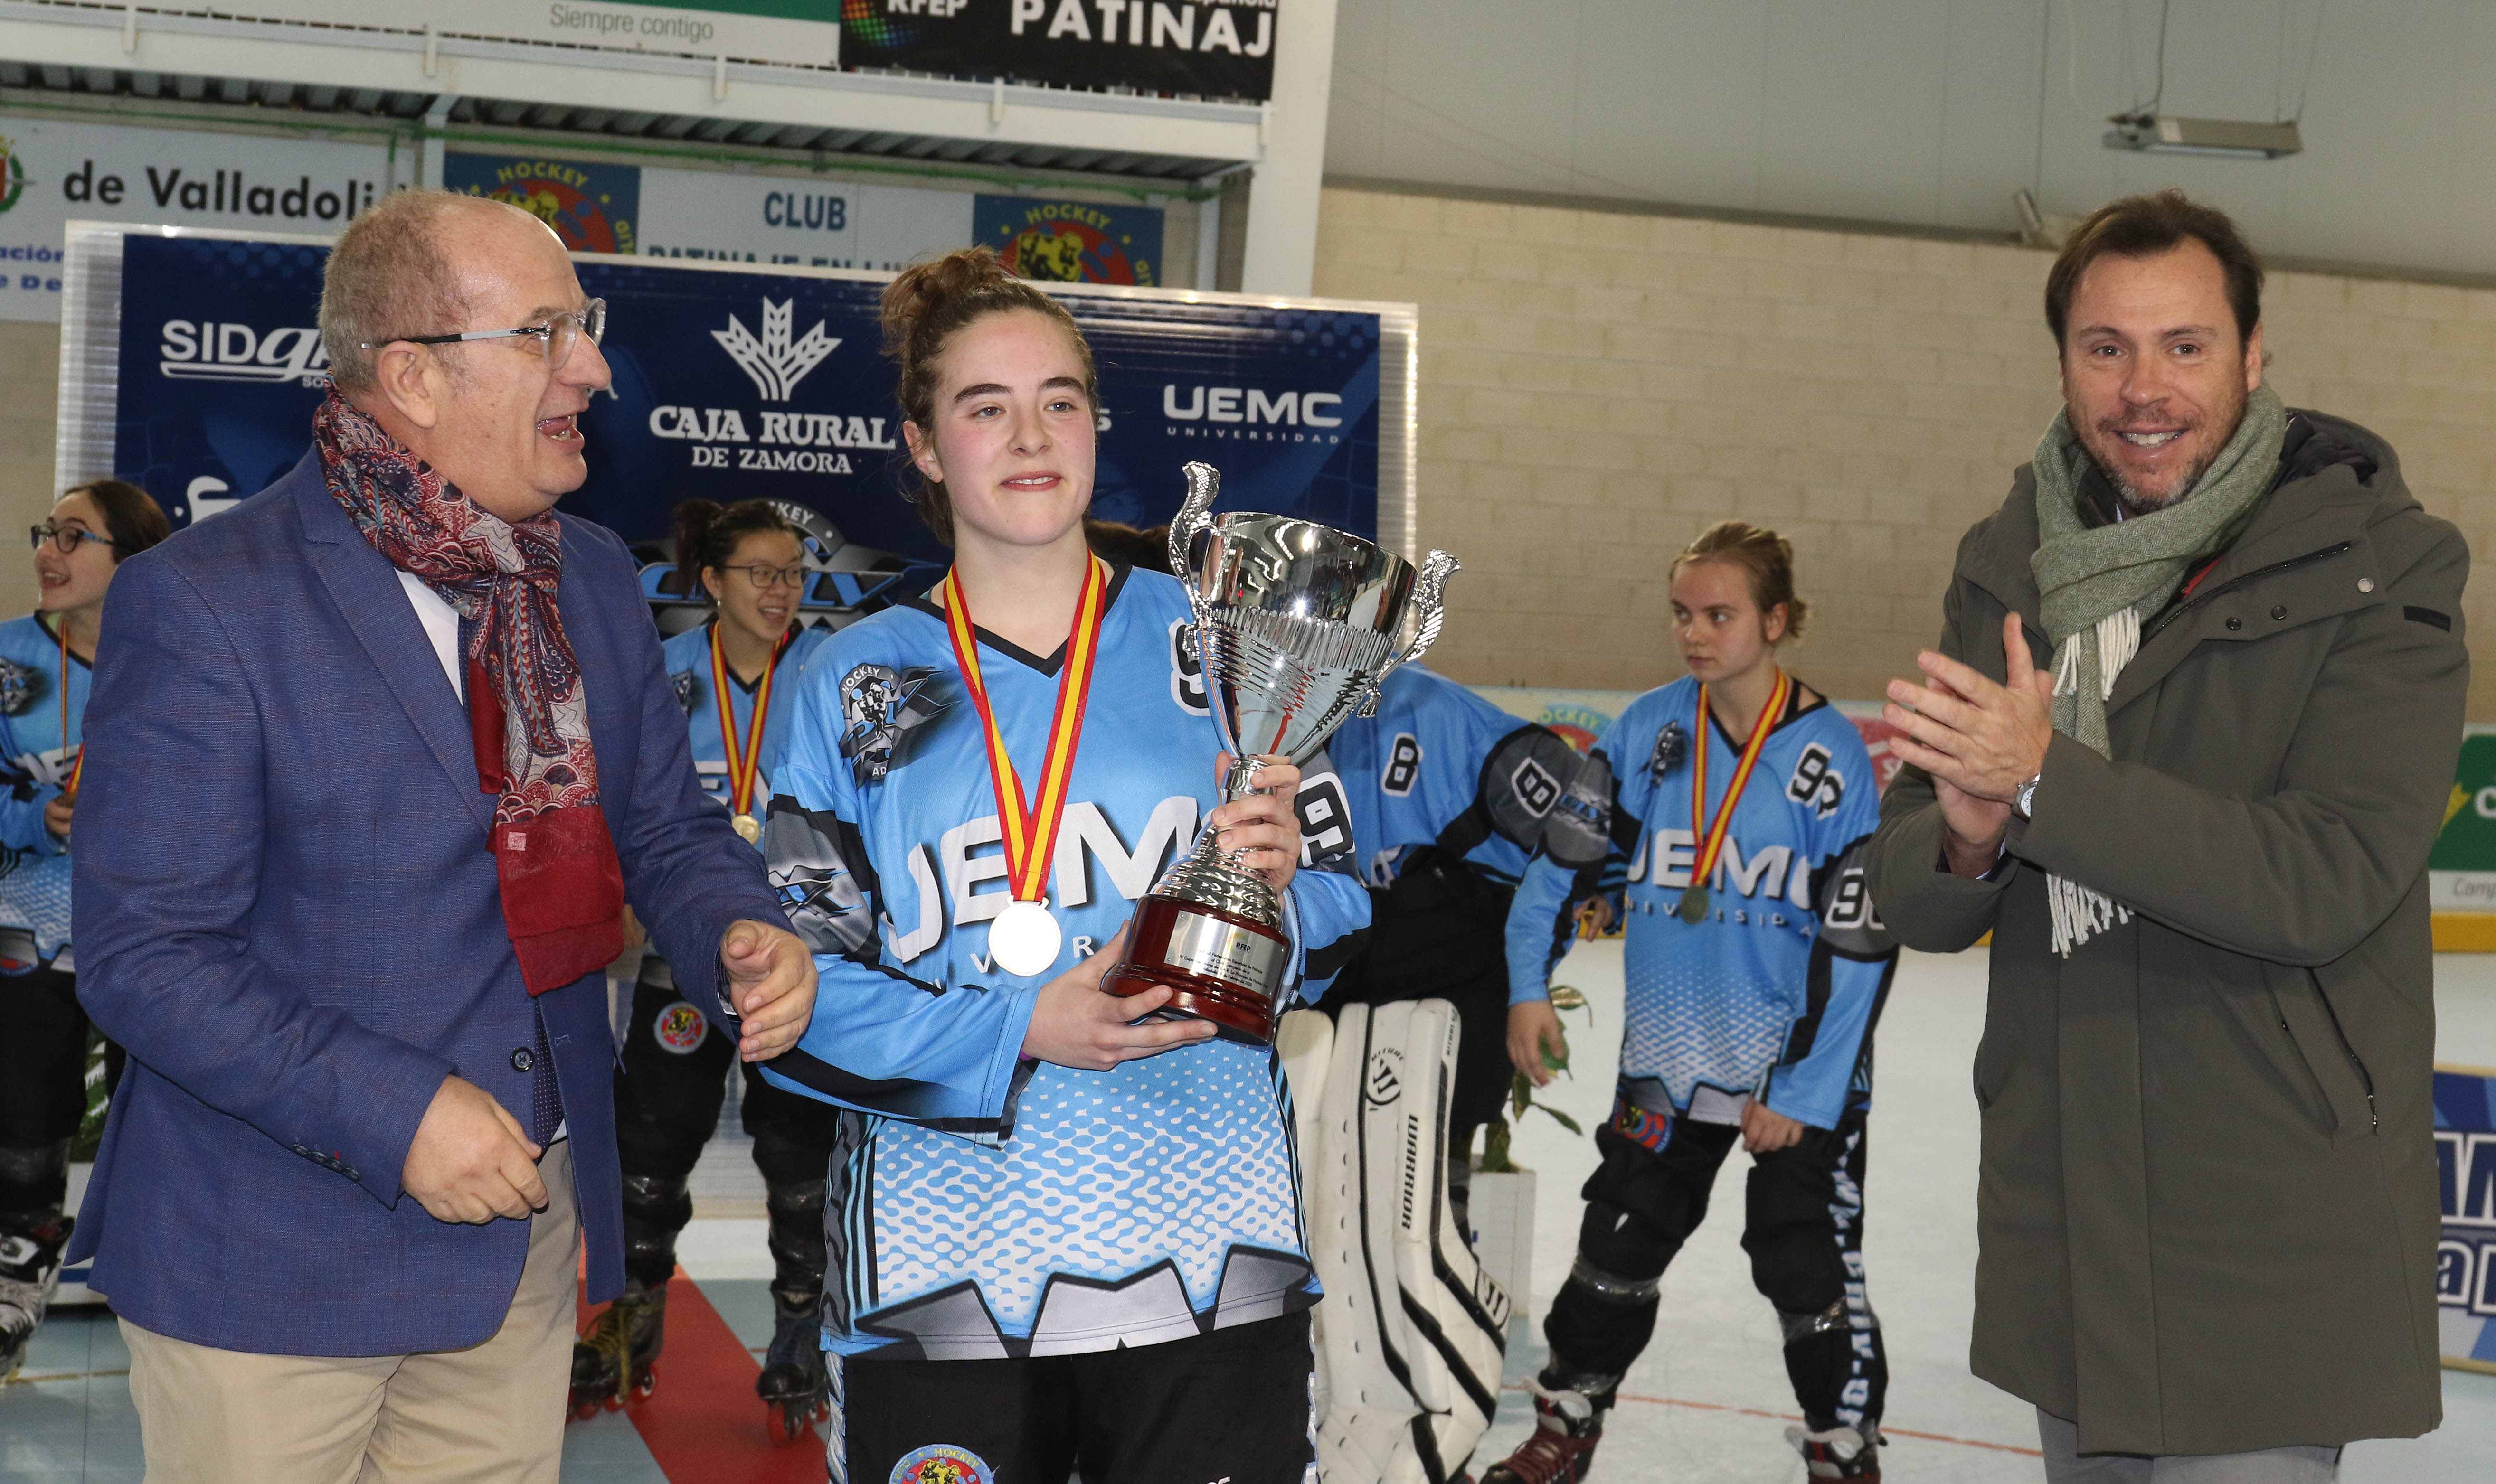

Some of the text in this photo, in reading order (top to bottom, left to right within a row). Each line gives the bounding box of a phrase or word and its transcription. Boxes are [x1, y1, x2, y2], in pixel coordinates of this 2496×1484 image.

[549, 4, 715, 44] Siempre contigo
[497, 161, 589, 188] HOCKEY
[63, 160, 374, 222] de Valladoli
[764, 192, 847, 230] CLUB
[1025, 203, 1111, 229] HOCKEY
[1163, 384, 1343, 428] UEMC
[649, 405, 897, 450] CAJA RURAL
[1166, 426, 1339, 444] UNIVERSIDAD
[691, 446, 854, 474] DE ZAMORA
[842, 665, 880, 695] HOCKEY
[1236, 941, 1251, 952] RFEP
[1401, 1113, 1419, 1230] WARRIOR
[934, 1447, 981, 1467] HOCKEY
